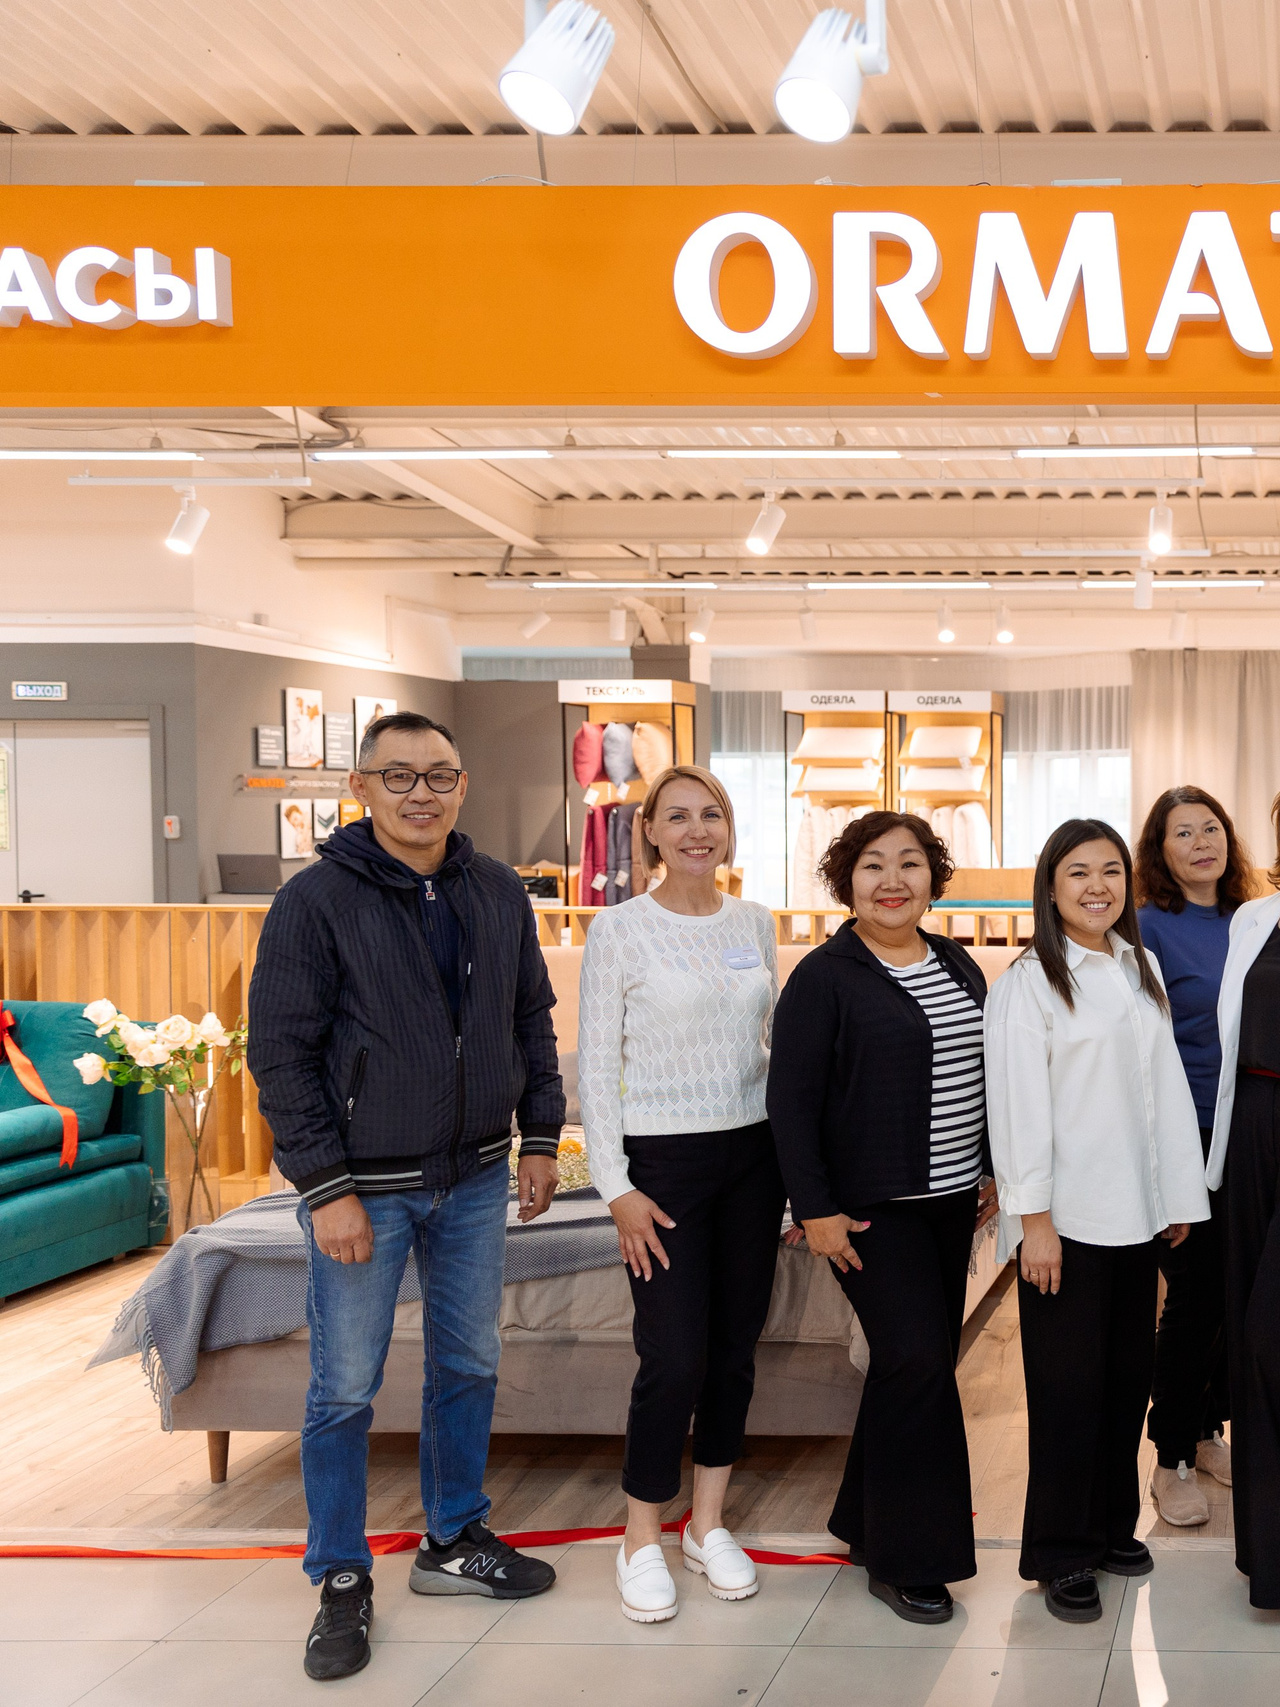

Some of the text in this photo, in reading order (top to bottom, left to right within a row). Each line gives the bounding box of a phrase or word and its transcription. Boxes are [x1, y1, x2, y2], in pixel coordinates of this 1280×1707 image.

[0, 245, 222, 326] АСЫ
[17, 685, 62, 697] ВЫХОД
[585, 686, 645, 696] ТЕКСТИЛЬ
[810, 695, 856, 705] ОДЕЯЛА
[916, 695, 962, 706] ОДЕЯЛА
